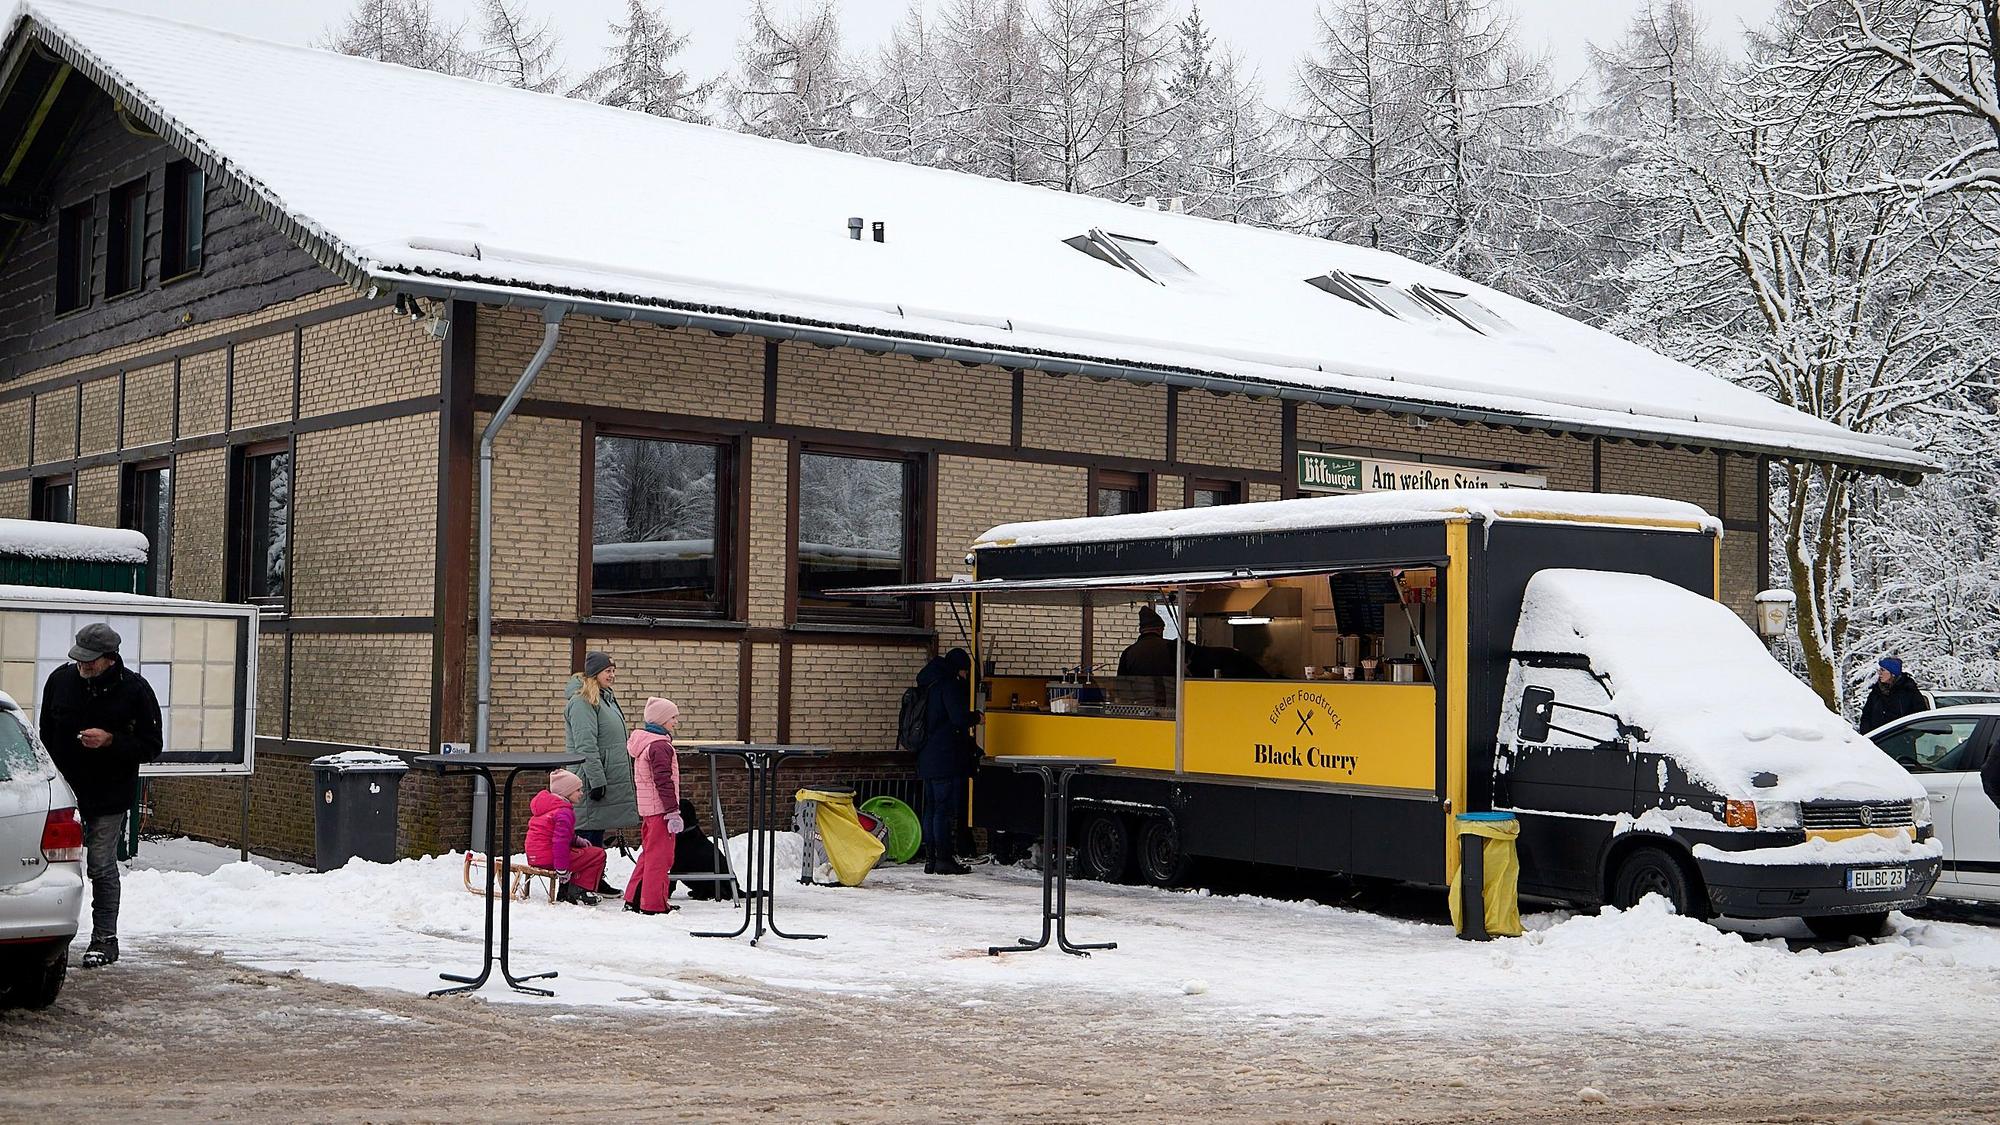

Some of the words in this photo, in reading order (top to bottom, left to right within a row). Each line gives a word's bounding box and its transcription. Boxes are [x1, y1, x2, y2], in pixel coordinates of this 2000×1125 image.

[1372, 464, 1396, 490] Am
[1400, 469, 1450, 490] weißen
[1269, 693, 1296, 725] Eifeler
[1298, 689, 1342, 730] Foodtruck
[1254, 743, 1303, 767] Black
[1306, 746, 1359, 776] Curry
[1855, 872, 1869, 886] EU
[1875, 871, 1887, 886] BC
[1890, 870, 1902, 886] 23
